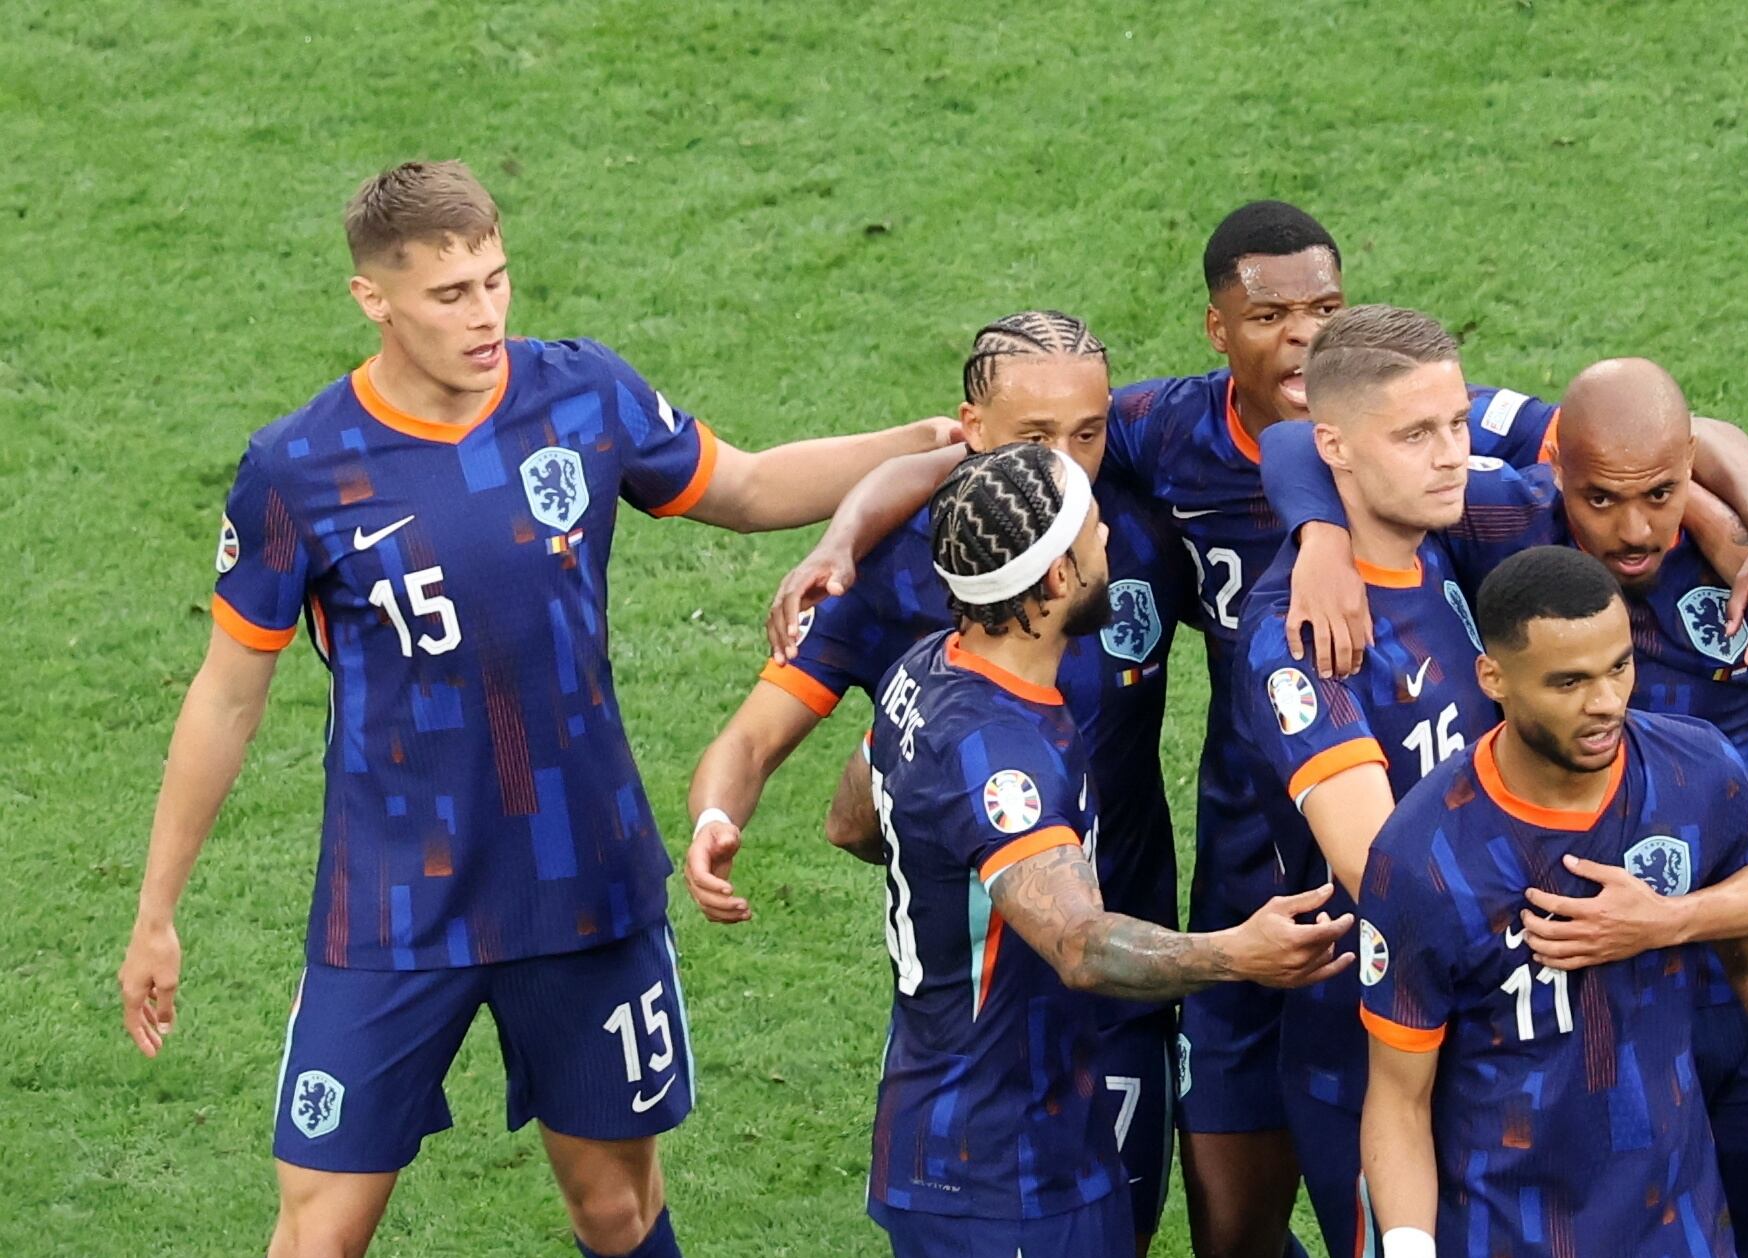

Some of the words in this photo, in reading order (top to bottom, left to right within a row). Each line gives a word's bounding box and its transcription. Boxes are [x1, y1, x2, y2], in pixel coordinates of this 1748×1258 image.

[368, 565, 462, 658] 15
[1401, 701, 1465, 778] 16
[603, 981, 676, 1083] 15
[1500, 963, 1574, 1041] 11
[1105, 1075, 1141, 1153] 7
